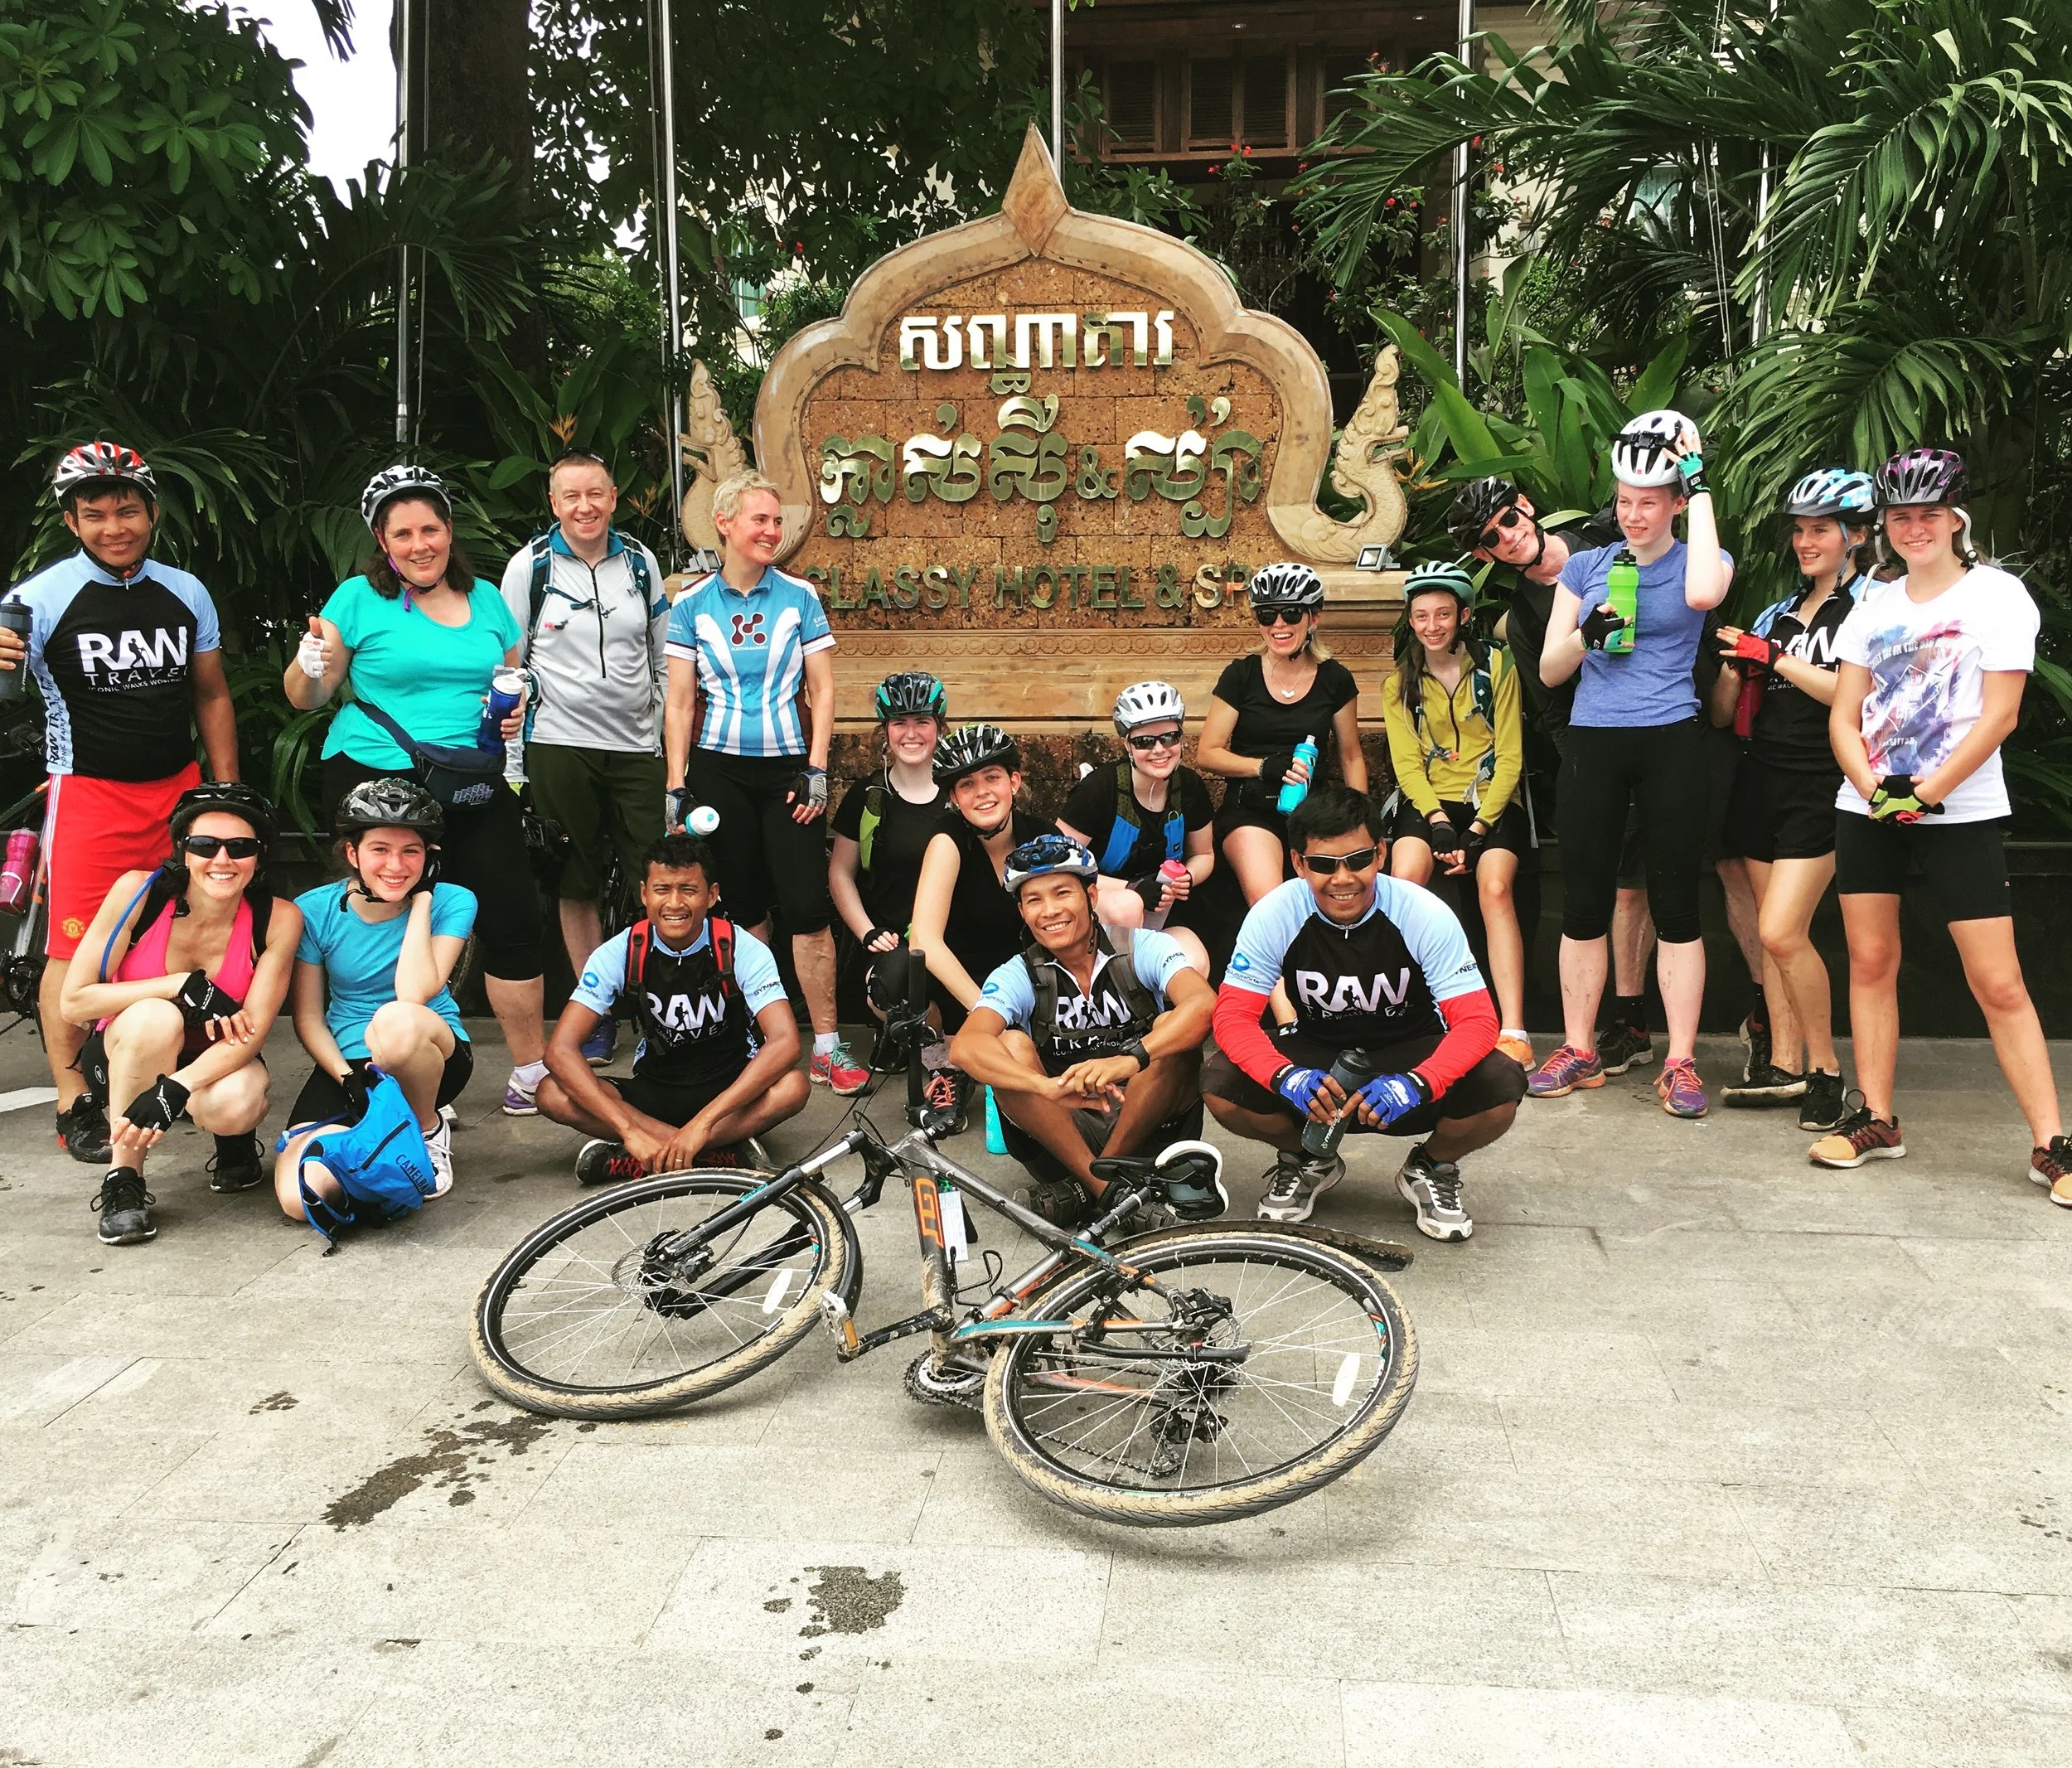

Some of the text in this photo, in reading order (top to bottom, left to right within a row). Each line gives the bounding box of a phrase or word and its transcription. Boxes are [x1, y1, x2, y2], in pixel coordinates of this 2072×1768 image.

[1076, 444, 1120, 500] &
[995, 564, 1146, 609] HOTEL
[1155, 564, 1184, 609] &
[1193, 564, 1252, 609] SP
[77, 626, 188, 672] RAW
[123, 681, 148, 690] WALKS
[1056, 989, 1131, 1030] RAW
[1295, 967, 1411, 1012] RAW
[915, 1178, 945, 1249] GT
[1074, 1182, 1087, 1203] GIRO
